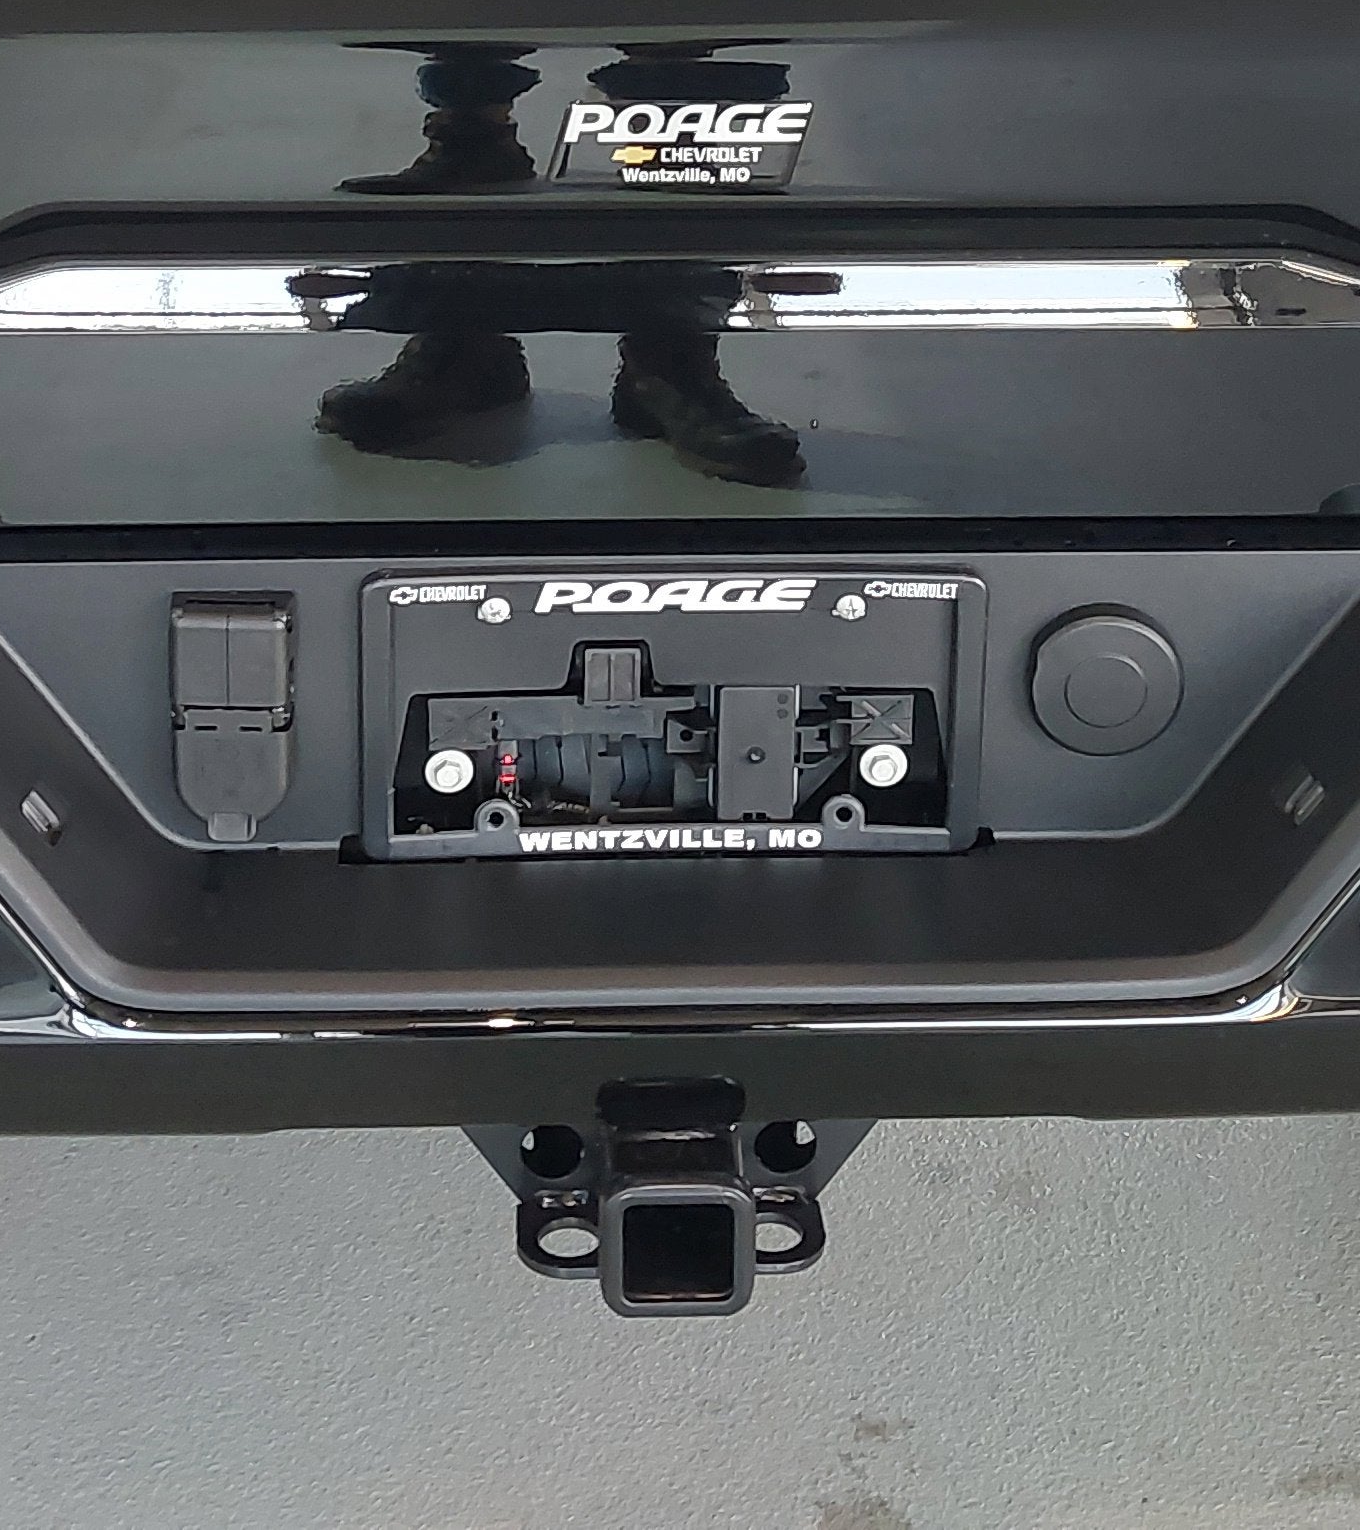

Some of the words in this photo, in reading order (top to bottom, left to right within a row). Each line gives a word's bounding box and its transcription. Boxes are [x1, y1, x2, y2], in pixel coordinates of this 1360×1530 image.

[563, 102, 813, 144] POAGE
[660, 146, 763, 163] CHEVROLET
[621, 167, 717, 185] Wentzville,
[719, 167, 752, 183] MO
[418, 584, 488, 603] CHEVROLET
[534, 578, 818, 614] POAGE
[890, 582, 959, 599] CHEVROLET
[518, 828, 756, 852] WENTZVILLE,
[767, 828, 822, 849] MO
